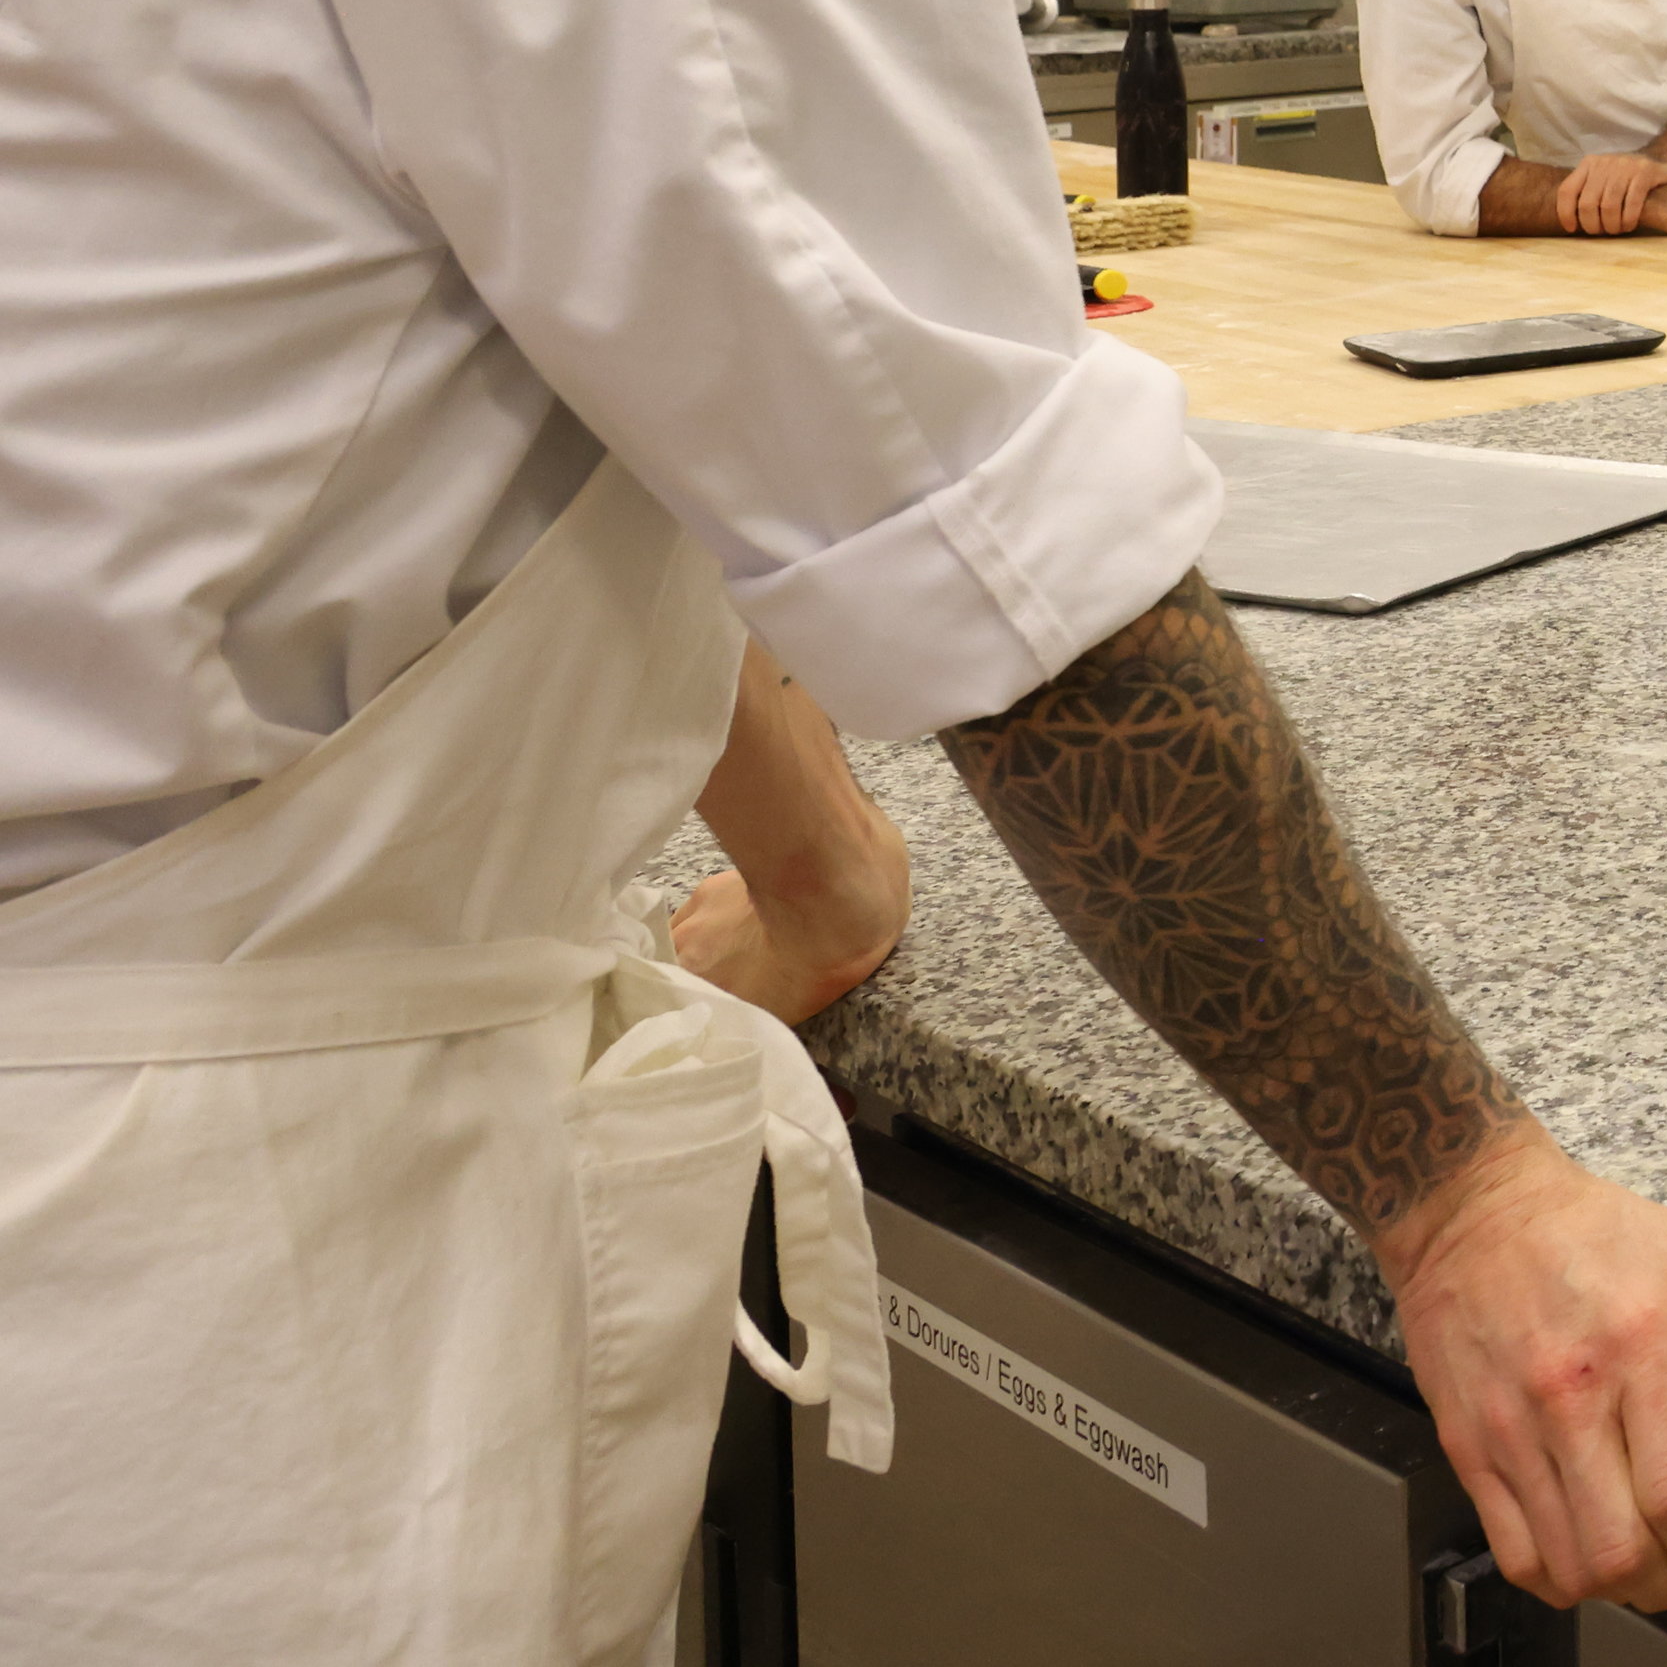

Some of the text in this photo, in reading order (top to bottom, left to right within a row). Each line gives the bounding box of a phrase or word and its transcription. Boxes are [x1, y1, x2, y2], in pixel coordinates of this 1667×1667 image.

[888, 1294, 1170, 1489] & Dorures / Eggs & Eggwash
